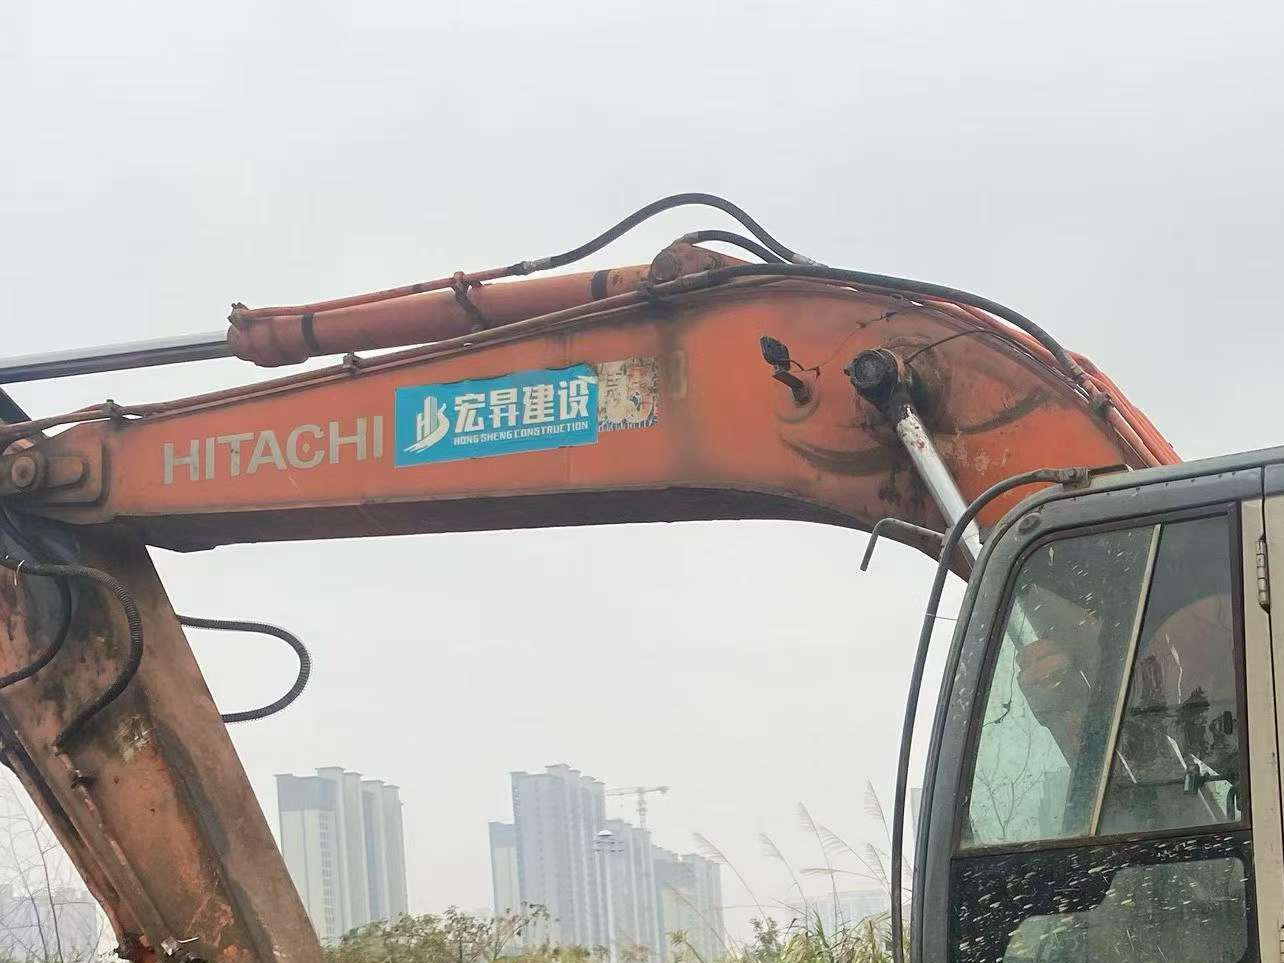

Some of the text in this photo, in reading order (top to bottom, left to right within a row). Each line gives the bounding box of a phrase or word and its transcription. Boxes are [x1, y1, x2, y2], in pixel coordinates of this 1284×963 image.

[163, 415, 384, 484] HITACHI
[453, 420, 589, 446] HONG SHENG CONSTRUCTION
